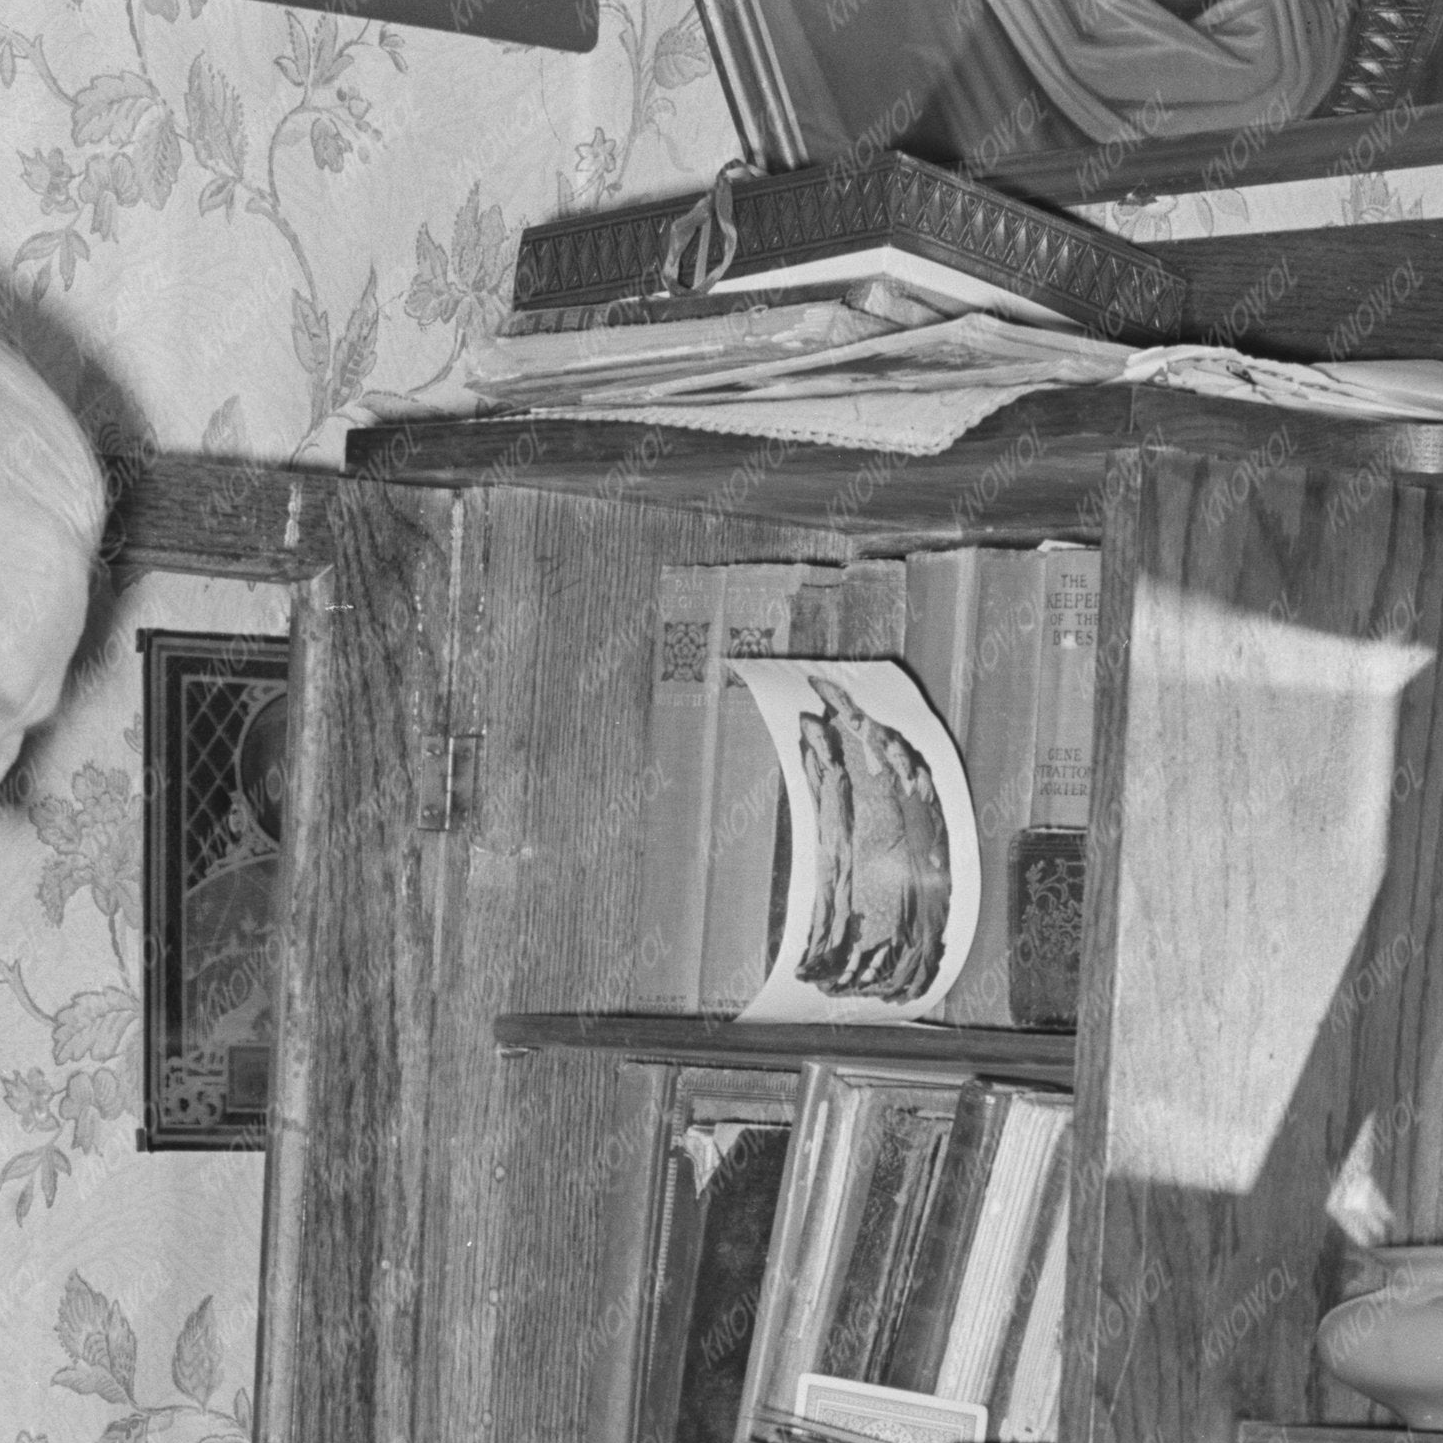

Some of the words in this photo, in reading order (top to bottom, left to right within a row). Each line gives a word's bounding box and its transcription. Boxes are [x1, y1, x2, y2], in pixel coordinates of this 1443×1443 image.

[1061, 574, 1088, 589] THE
[1050, 613, 1065, 626] OF
[1048, 748, 1082, 761] GENE
